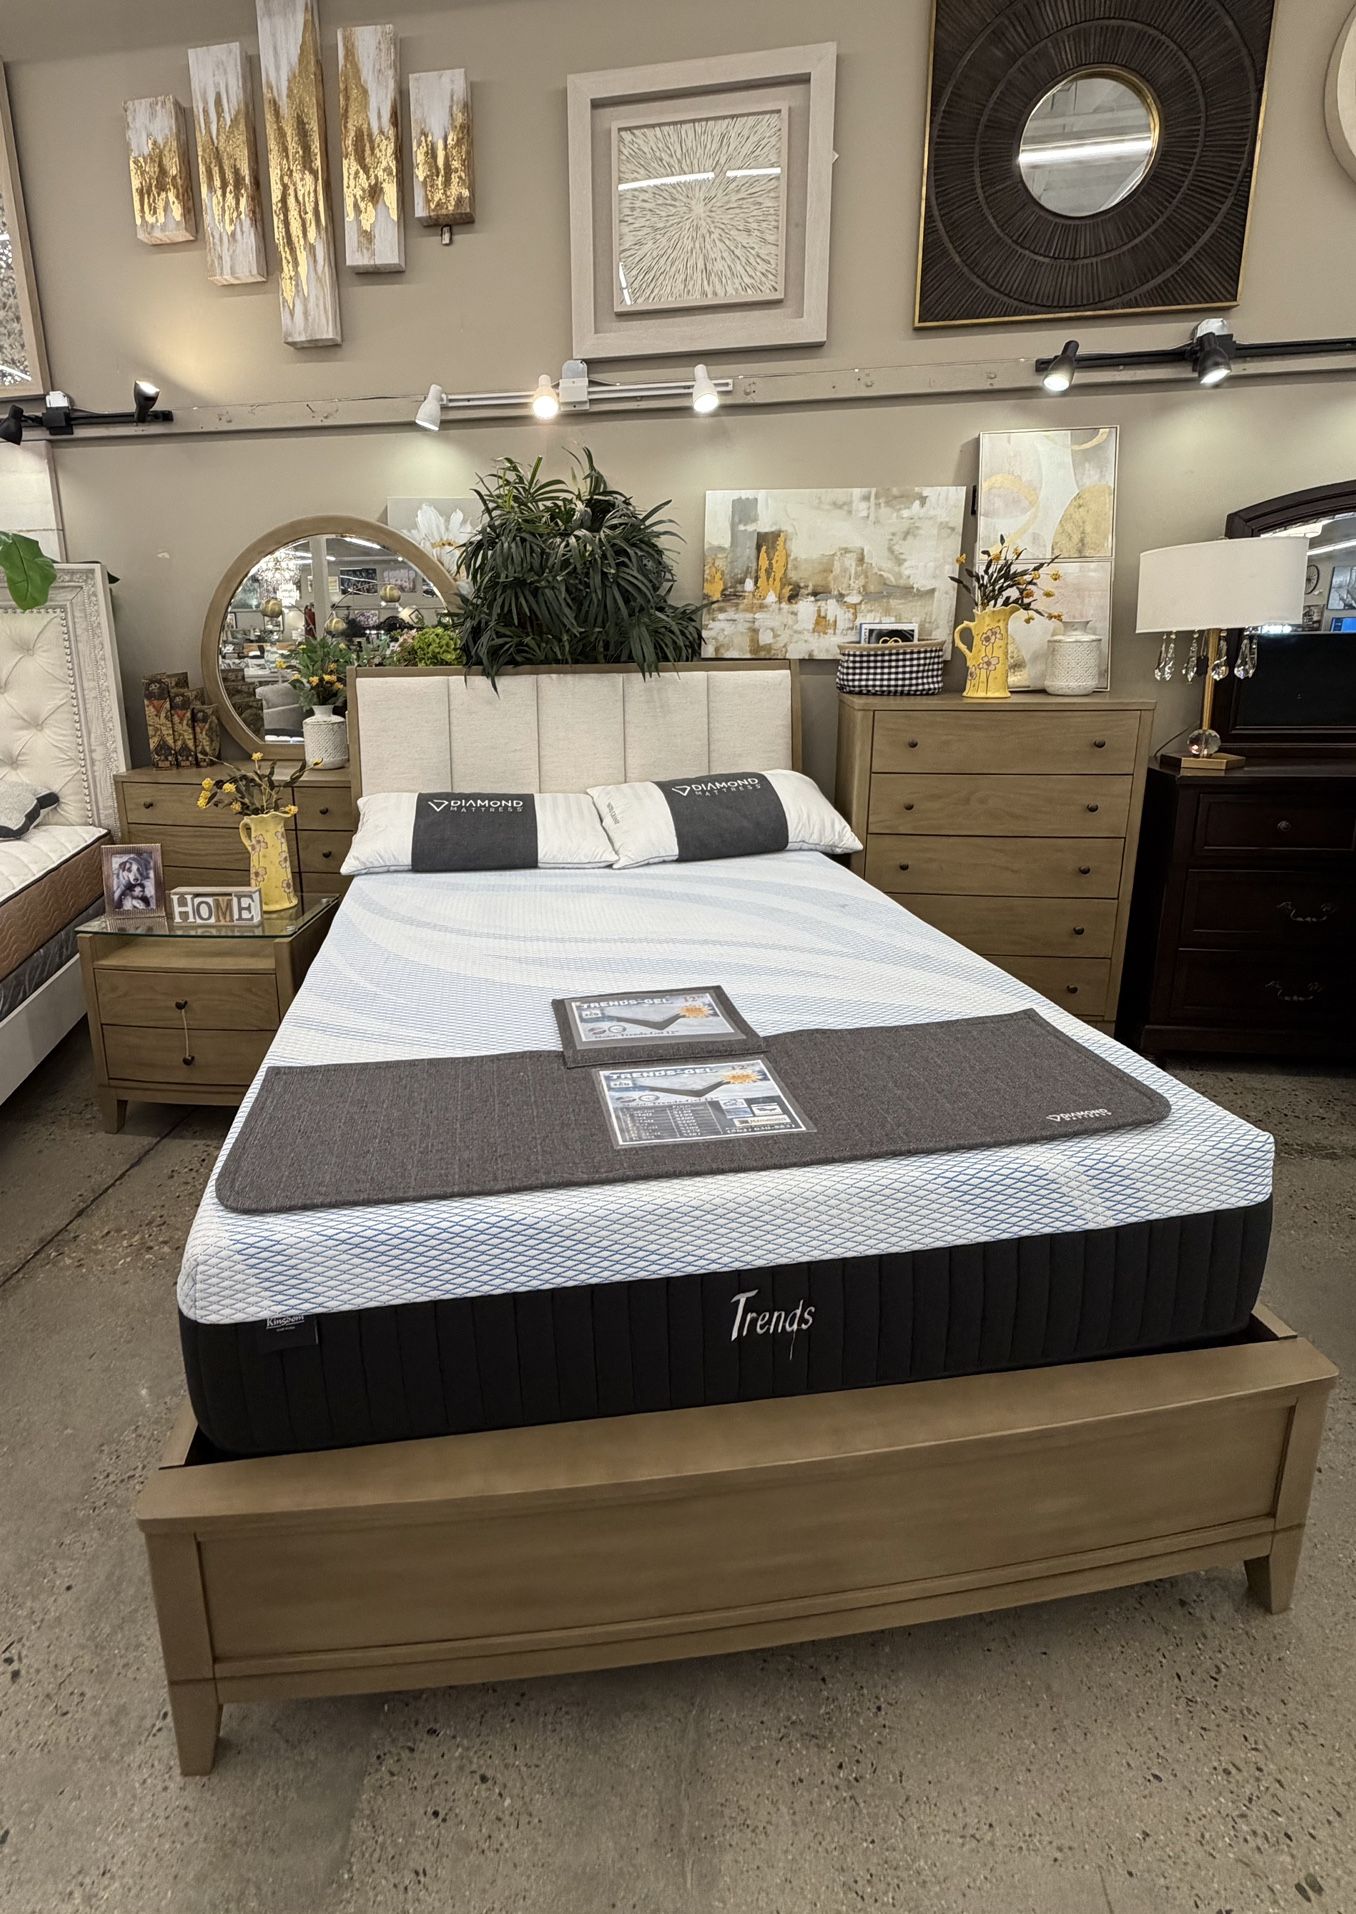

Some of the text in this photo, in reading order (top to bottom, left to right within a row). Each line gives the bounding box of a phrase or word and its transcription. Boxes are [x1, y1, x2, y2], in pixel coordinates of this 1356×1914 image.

[691, 778, 758, 790] DIAMOND
[450, 799, 523, 808] DIAMOND
[171, 894, 255, 922] HOME
[730, 1289, 815, 1341] Trends
